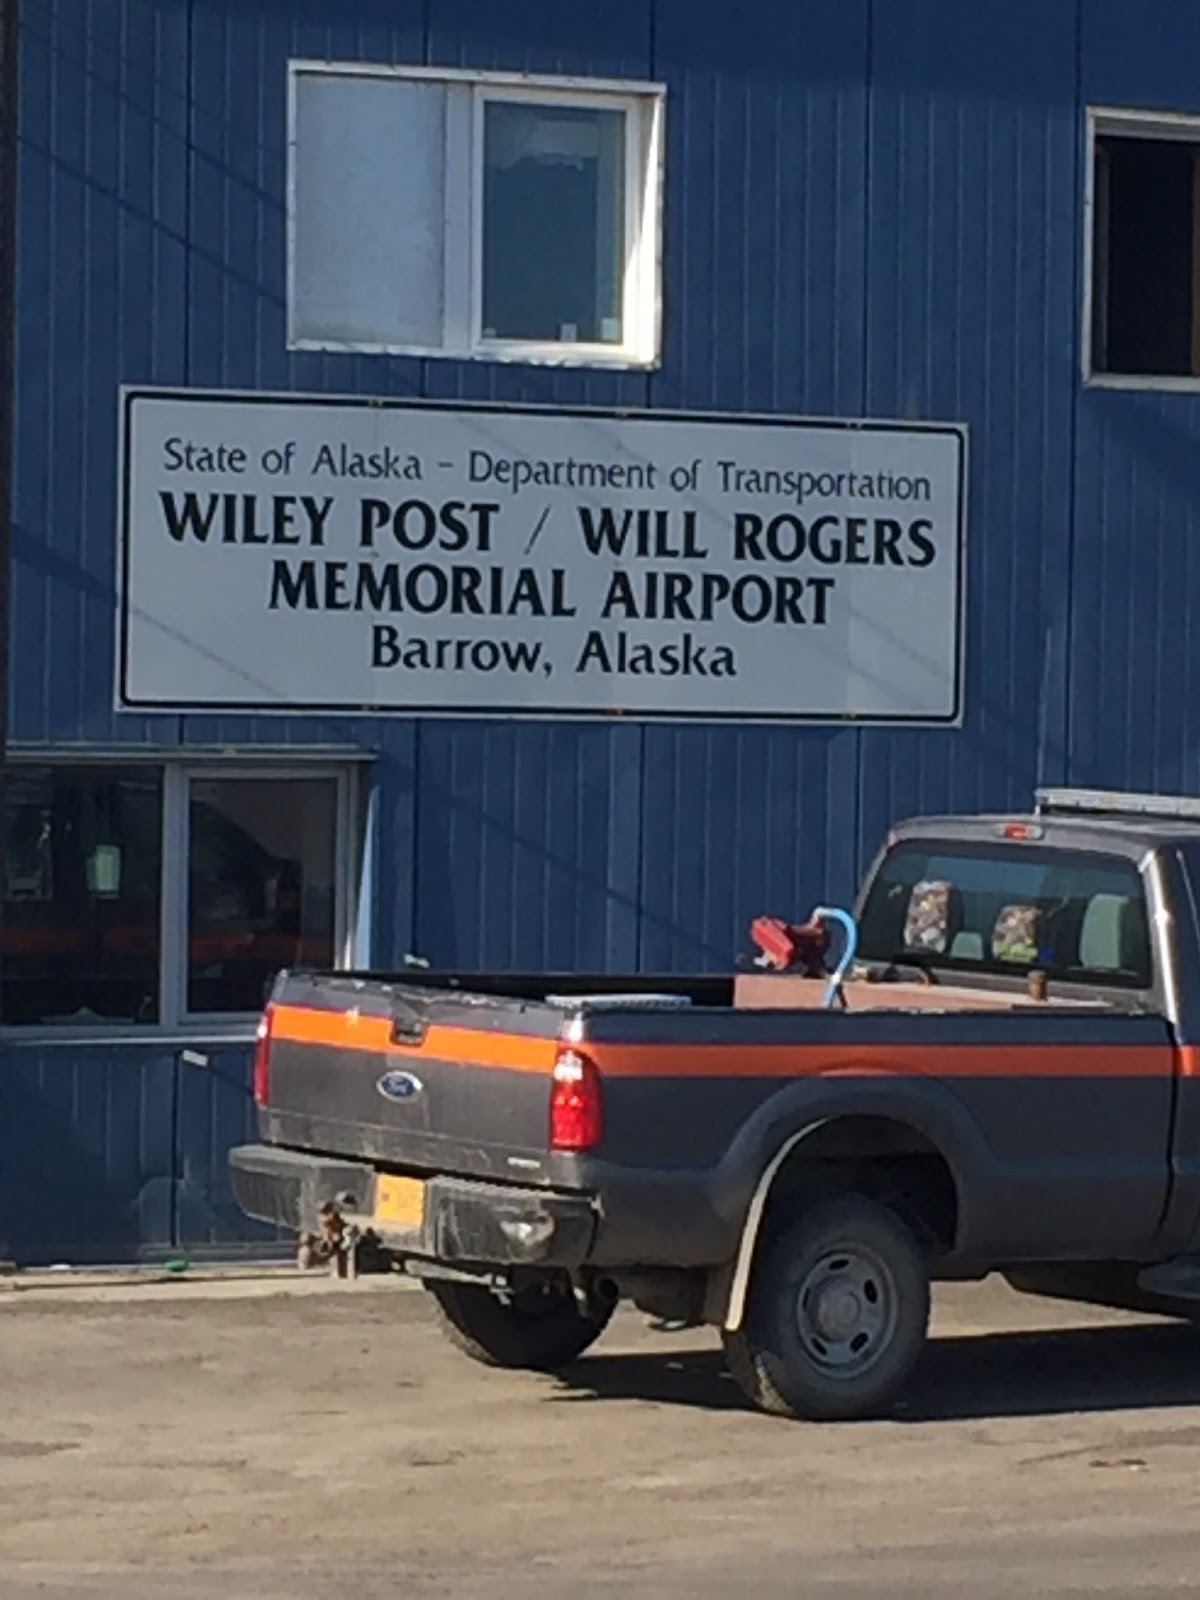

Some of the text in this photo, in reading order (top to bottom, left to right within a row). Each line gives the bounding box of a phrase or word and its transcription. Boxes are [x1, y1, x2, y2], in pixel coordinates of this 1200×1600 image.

[164, 437, 247, 473] State
[261, 442, 297, 475] of
[311, 443, 422, 480] Alaska
[469, 450, 657, 494] Department
[669, 459, 703, 492] of
[717, 460, 931, 504] Transportation
[159, 491, 334, 546] WILEY
[359, 498, 500, 552] POST
[578, 506, 708, 559] WILL
[734, 513, 936, 568] ROGERS
[269, 560, 835, 625] MEMORIAL AIRPORT
[371, 624, 737, 677] Barrow, Alaska
